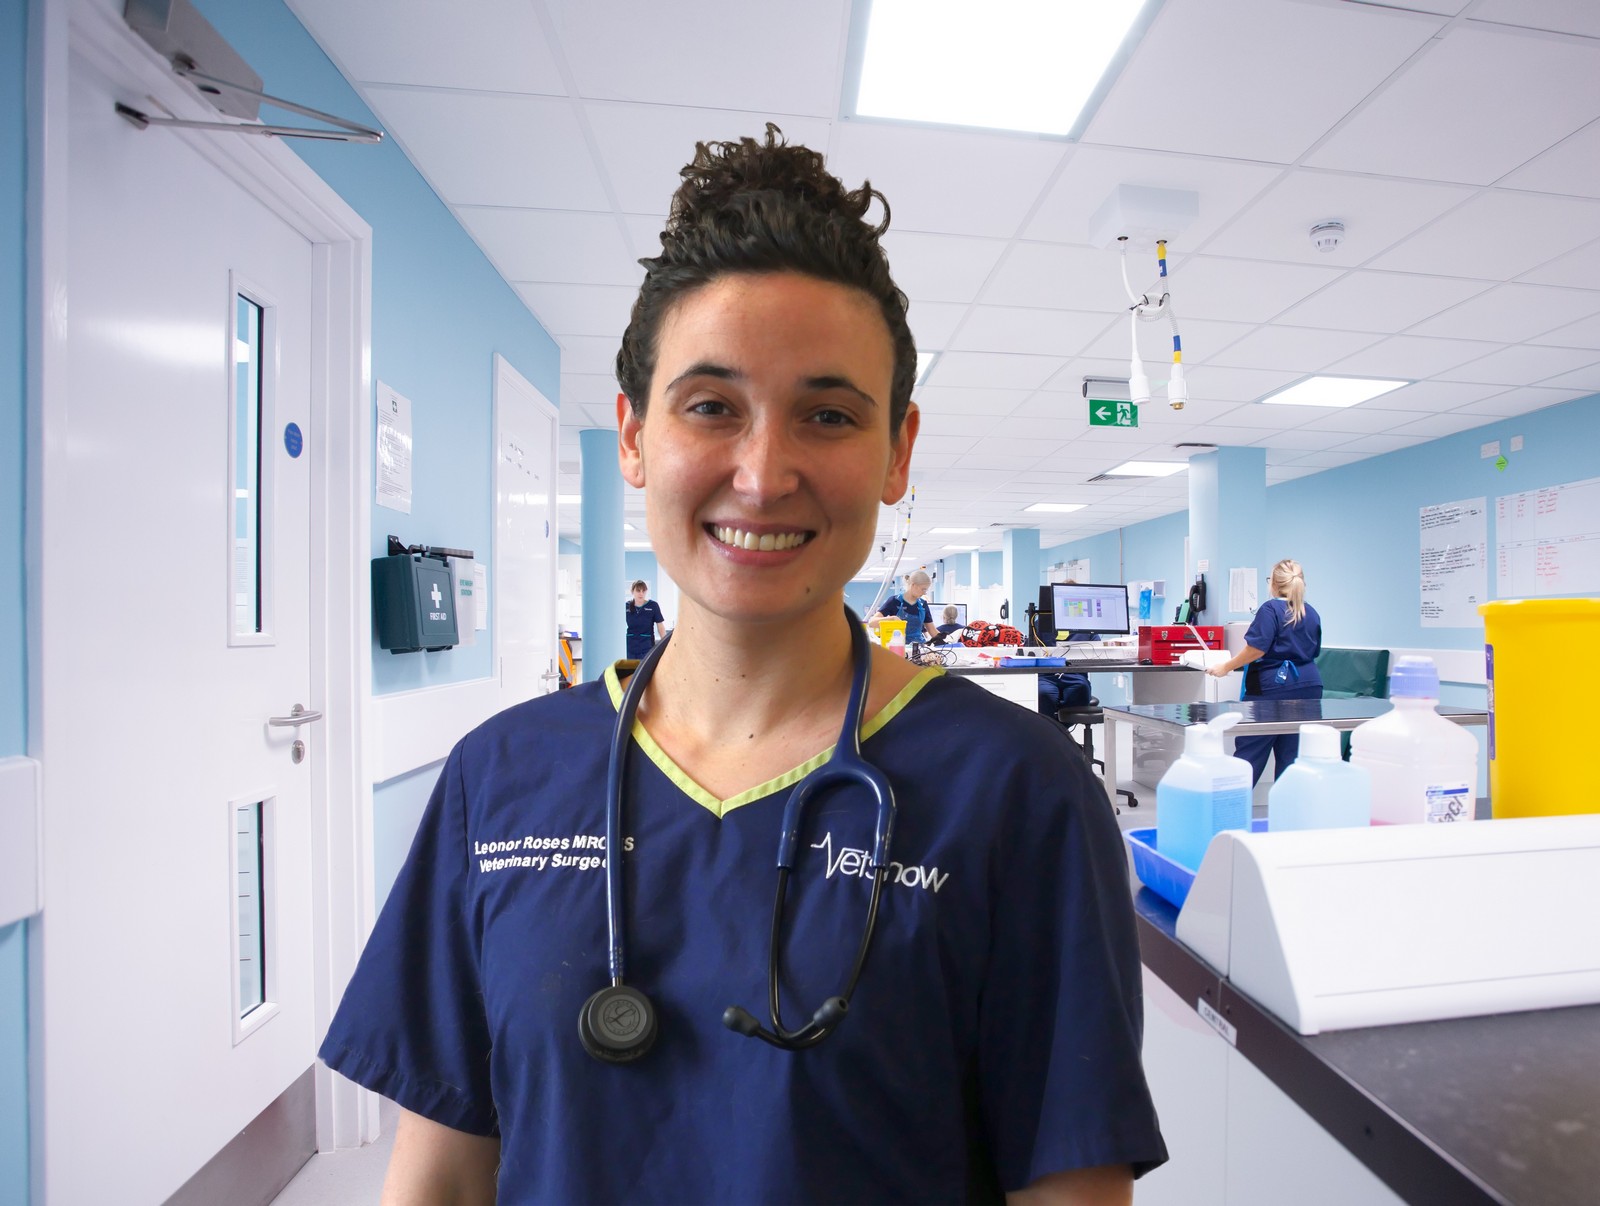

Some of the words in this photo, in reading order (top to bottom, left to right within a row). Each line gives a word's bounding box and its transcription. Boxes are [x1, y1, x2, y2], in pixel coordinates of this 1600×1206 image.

[474, 840, 521, 855] Leonor
[523, 835, 570, 850] Roses
[571, 834, 634, 851] MRCS
[479, 854, 549, 873] Veterinary
[551, 853, 607, 871] Surge
